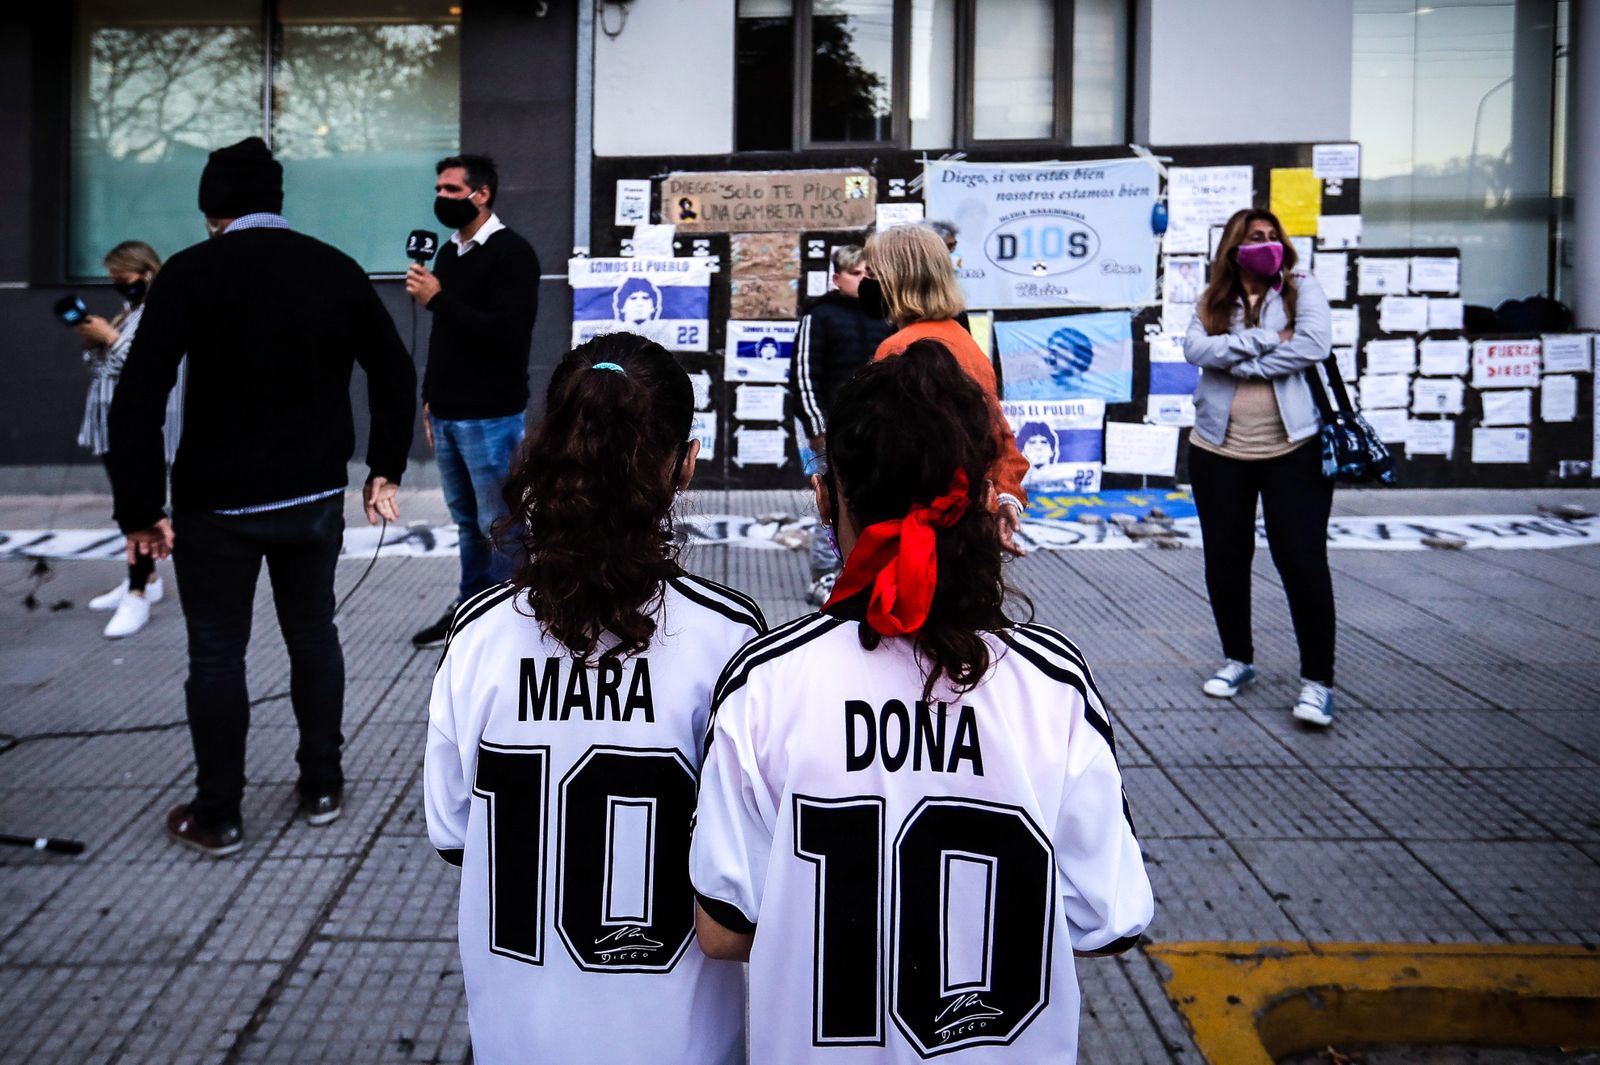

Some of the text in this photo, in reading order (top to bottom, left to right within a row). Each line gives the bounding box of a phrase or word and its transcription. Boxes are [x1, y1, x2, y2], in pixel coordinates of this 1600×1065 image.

[942, 170, 989, 188] Diego,
[993, 169, 1006, 183] si
[1009, 173, 1032, 183] vos
[1073, 167, 1105, 180] bien
[772, 184, 793, 199] TE
[996, 184, 1150, 201] nosotros estamos bien
[701, 204, 730, 221] UNA
[733, 203, 805, 221] GAMBETA
[590, 261, 690, 273] SOMOS EL PUEBLO
[677, 326, 699, 345] 22
[1029, 405, 1039, 416] EL
[1043, 404, 1085, 416] PUEBLO
[1074, 469, 1094, 487] 22
[518, 657, 656, 724] MARA
[845, 698, 984, 777] DONA
[471, 739, 700, 973] 10
[792, 794, 1057, 1061] 10
[600, 951, 649, 964] DIEGO
[939, 1021, 987, 1045] DIEGO
